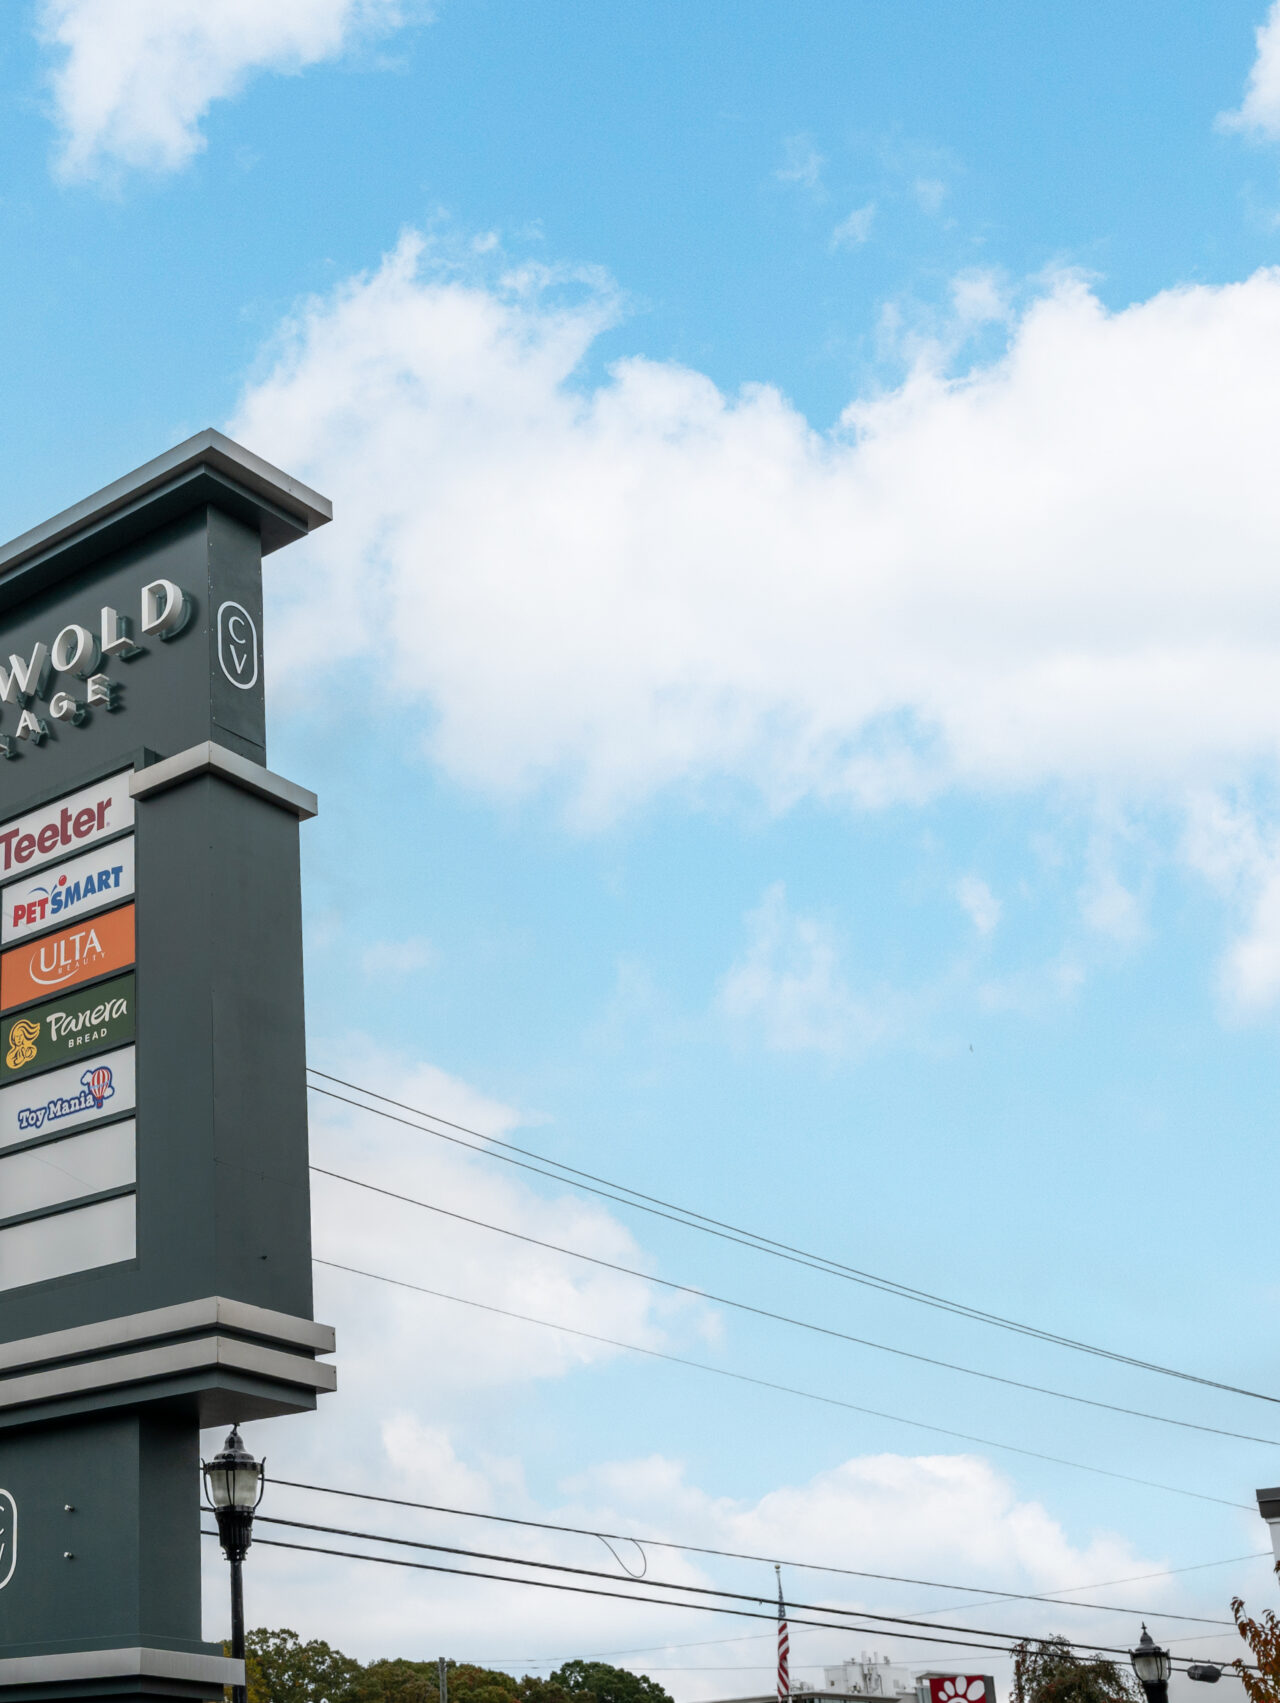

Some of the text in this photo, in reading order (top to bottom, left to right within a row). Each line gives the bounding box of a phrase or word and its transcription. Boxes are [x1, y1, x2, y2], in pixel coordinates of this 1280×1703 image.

[40, 928, 102, 973] ULTA
[58, 951, 106, 975] BEAUTY
[46, 998, 127, 1042] Panera
[68, 1028, 107, 1048] BREAD
[18, 1091, 95, 1130] Toy Mania
